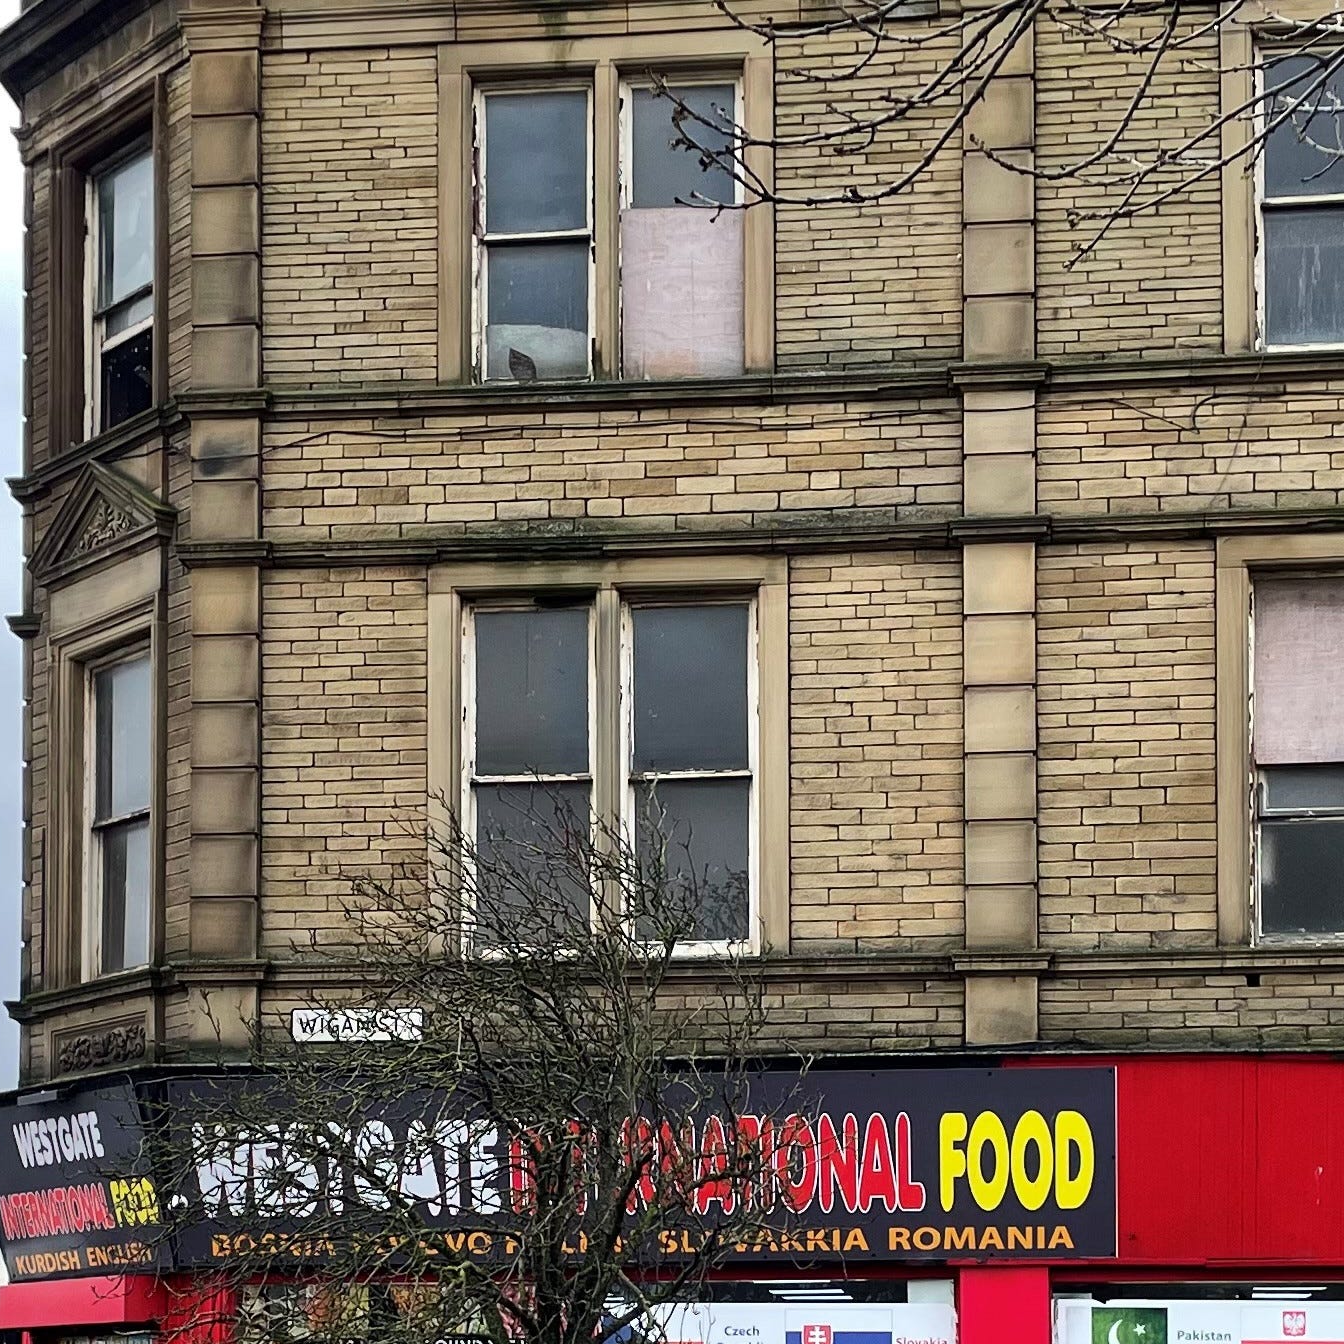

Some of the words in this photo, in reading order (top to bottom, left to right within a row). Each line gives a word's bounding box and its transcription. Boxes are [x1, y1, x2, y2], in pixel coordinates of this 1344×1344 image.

[13, 1111, 105, 1168] WESTGATE
[938, 1110, 1094, 1211] FOOD
[110, 1177, 160, 1228] FOOD
[888, 1225, 1074, 1251] ROMANIA
[16, 1252, 81, 1275] KURDISH
[87, 1242, 152, 1268] ENGLISH
[724, 1325, 761, 1337] Czech
[1177, 1329, 1232, 1342] Pakistan
